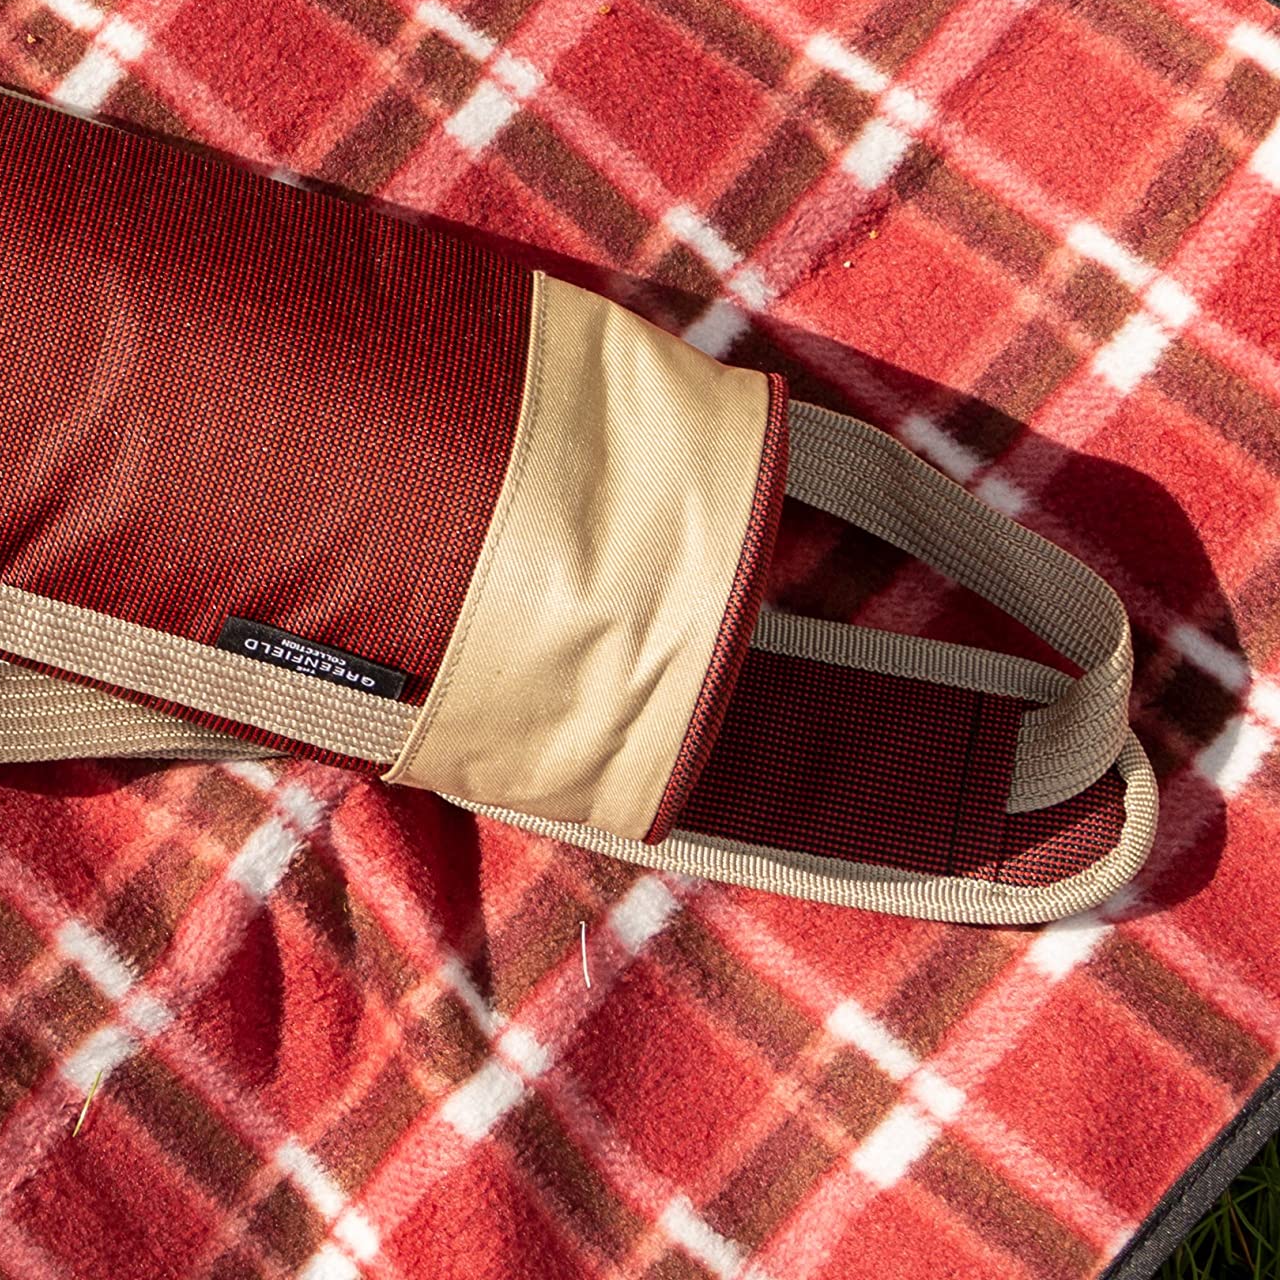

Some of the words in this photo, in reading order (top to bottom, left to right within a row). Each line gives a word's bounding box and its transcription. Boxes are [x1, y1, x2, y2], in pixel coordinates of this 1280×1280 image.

[244, 638, 376, 687] GREENFIELD
[281, 638, 347, 666] COLLECTION
[296, 665, 317, 675] THE
